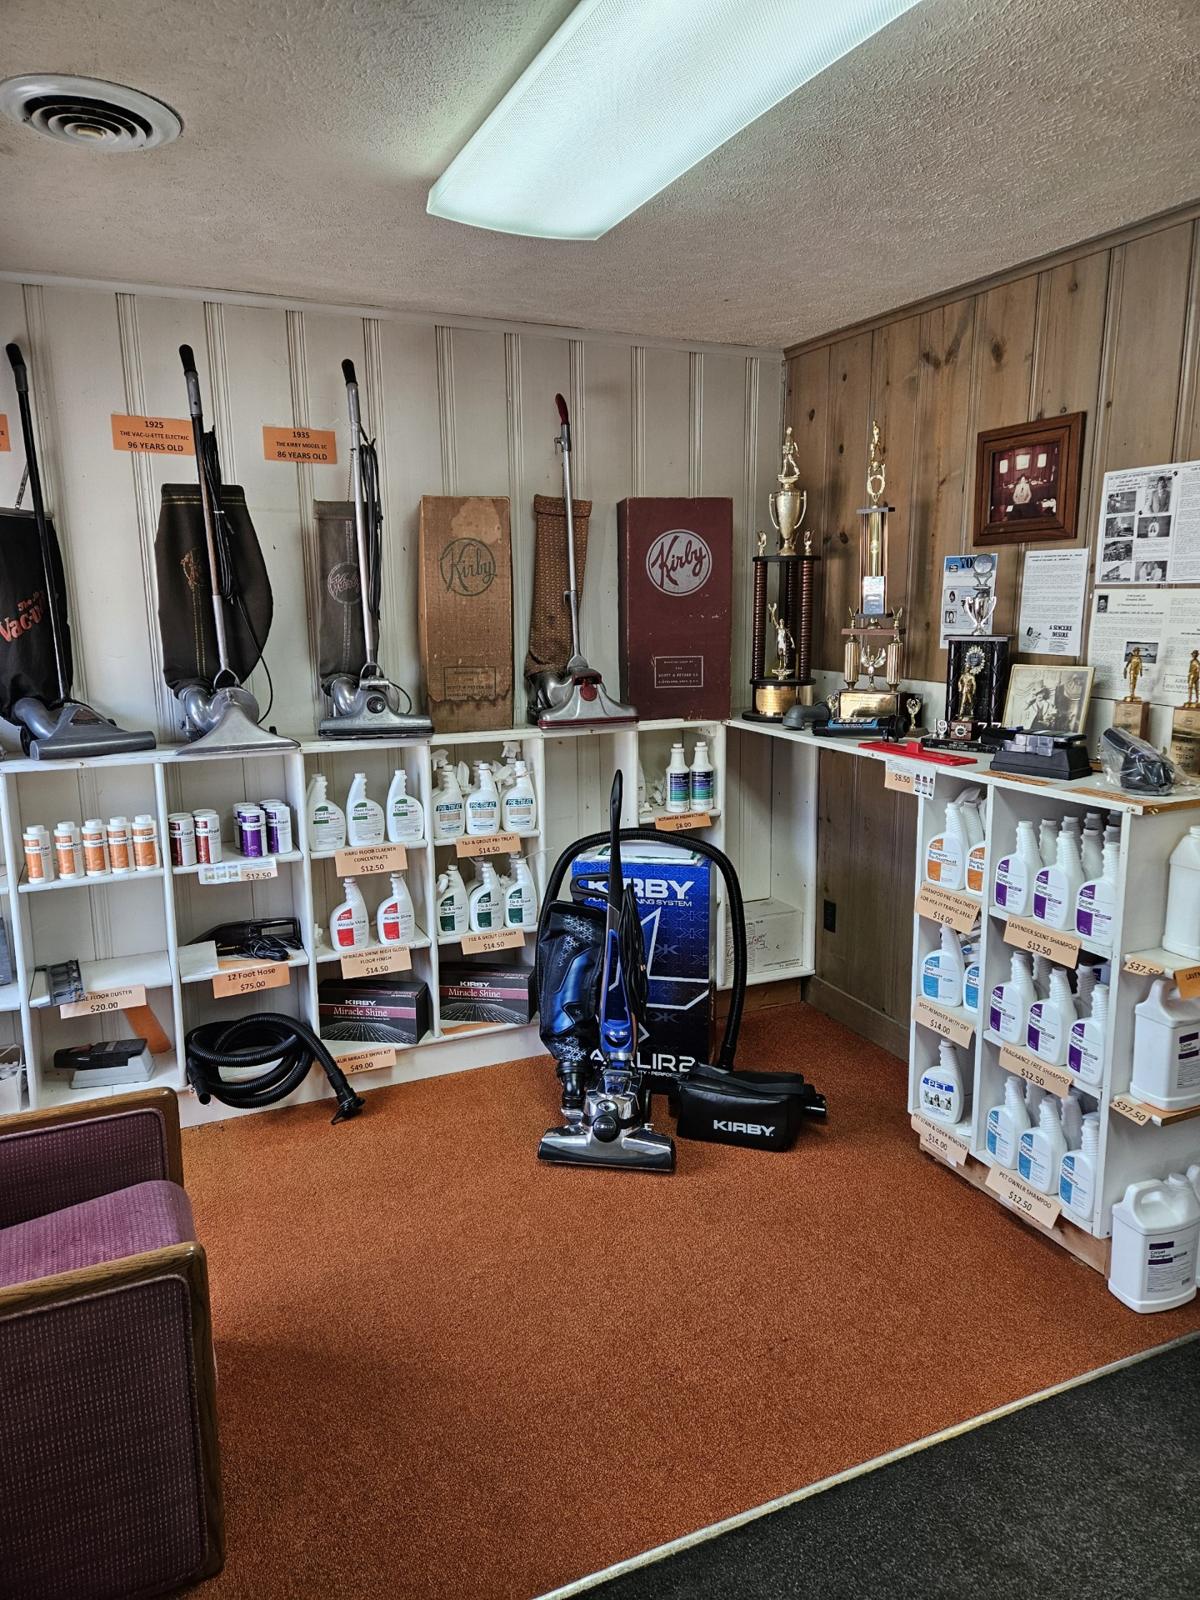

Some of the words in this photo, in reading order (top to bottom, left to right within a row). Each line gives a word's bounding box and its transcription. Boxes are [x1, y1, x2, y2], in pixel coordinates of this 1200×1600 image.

[440, 543, 498, 592] Kirby
[651, 535, 706, 588] Kirby
[361, 864, 384, 872] $12.50
[588, 878, 695, 900] KRBY
[1008, 922, 1033, 935] LAVENDER
[1034, 931, 1049, 941] SCENT
[1050, 936, 1077, 951] SHAMPOO
[484, 942, 504, 950] $14.50
[1027, 941, 1052, 956] $12.50
[366, 966, 389, 974] $14.50
[240, 981, 266, 991] $75.00
[449, 988, 477, 997] Miracle
[91, 1002, 118, 1012] $20.00
[333, 1007, 364, 1016] Miracle
[365, 1008, 388, 1016] Shine
[930, 1019, 950, 1034] $14.00
[351, 1062, 373, 1072] $49.00
[1002, 1047, 1030, 1064] FRAGRANCE
[1030, 1060, 1042, 1071] FREE
[1042, 1068, 1069, 1084] SHAMPOO
[1021, 1068, 1044, 1086] $12.50
[1114, 1101, 1146, 1122] $37.50
[713, 1120, 775, 1136] KIRBY
[1008, 1178, 1026, 1192] OWNER
[1026, 1189, 1052, 1208] SHAMPOO
[1008, 1191, 1032, 1211] $12.50
